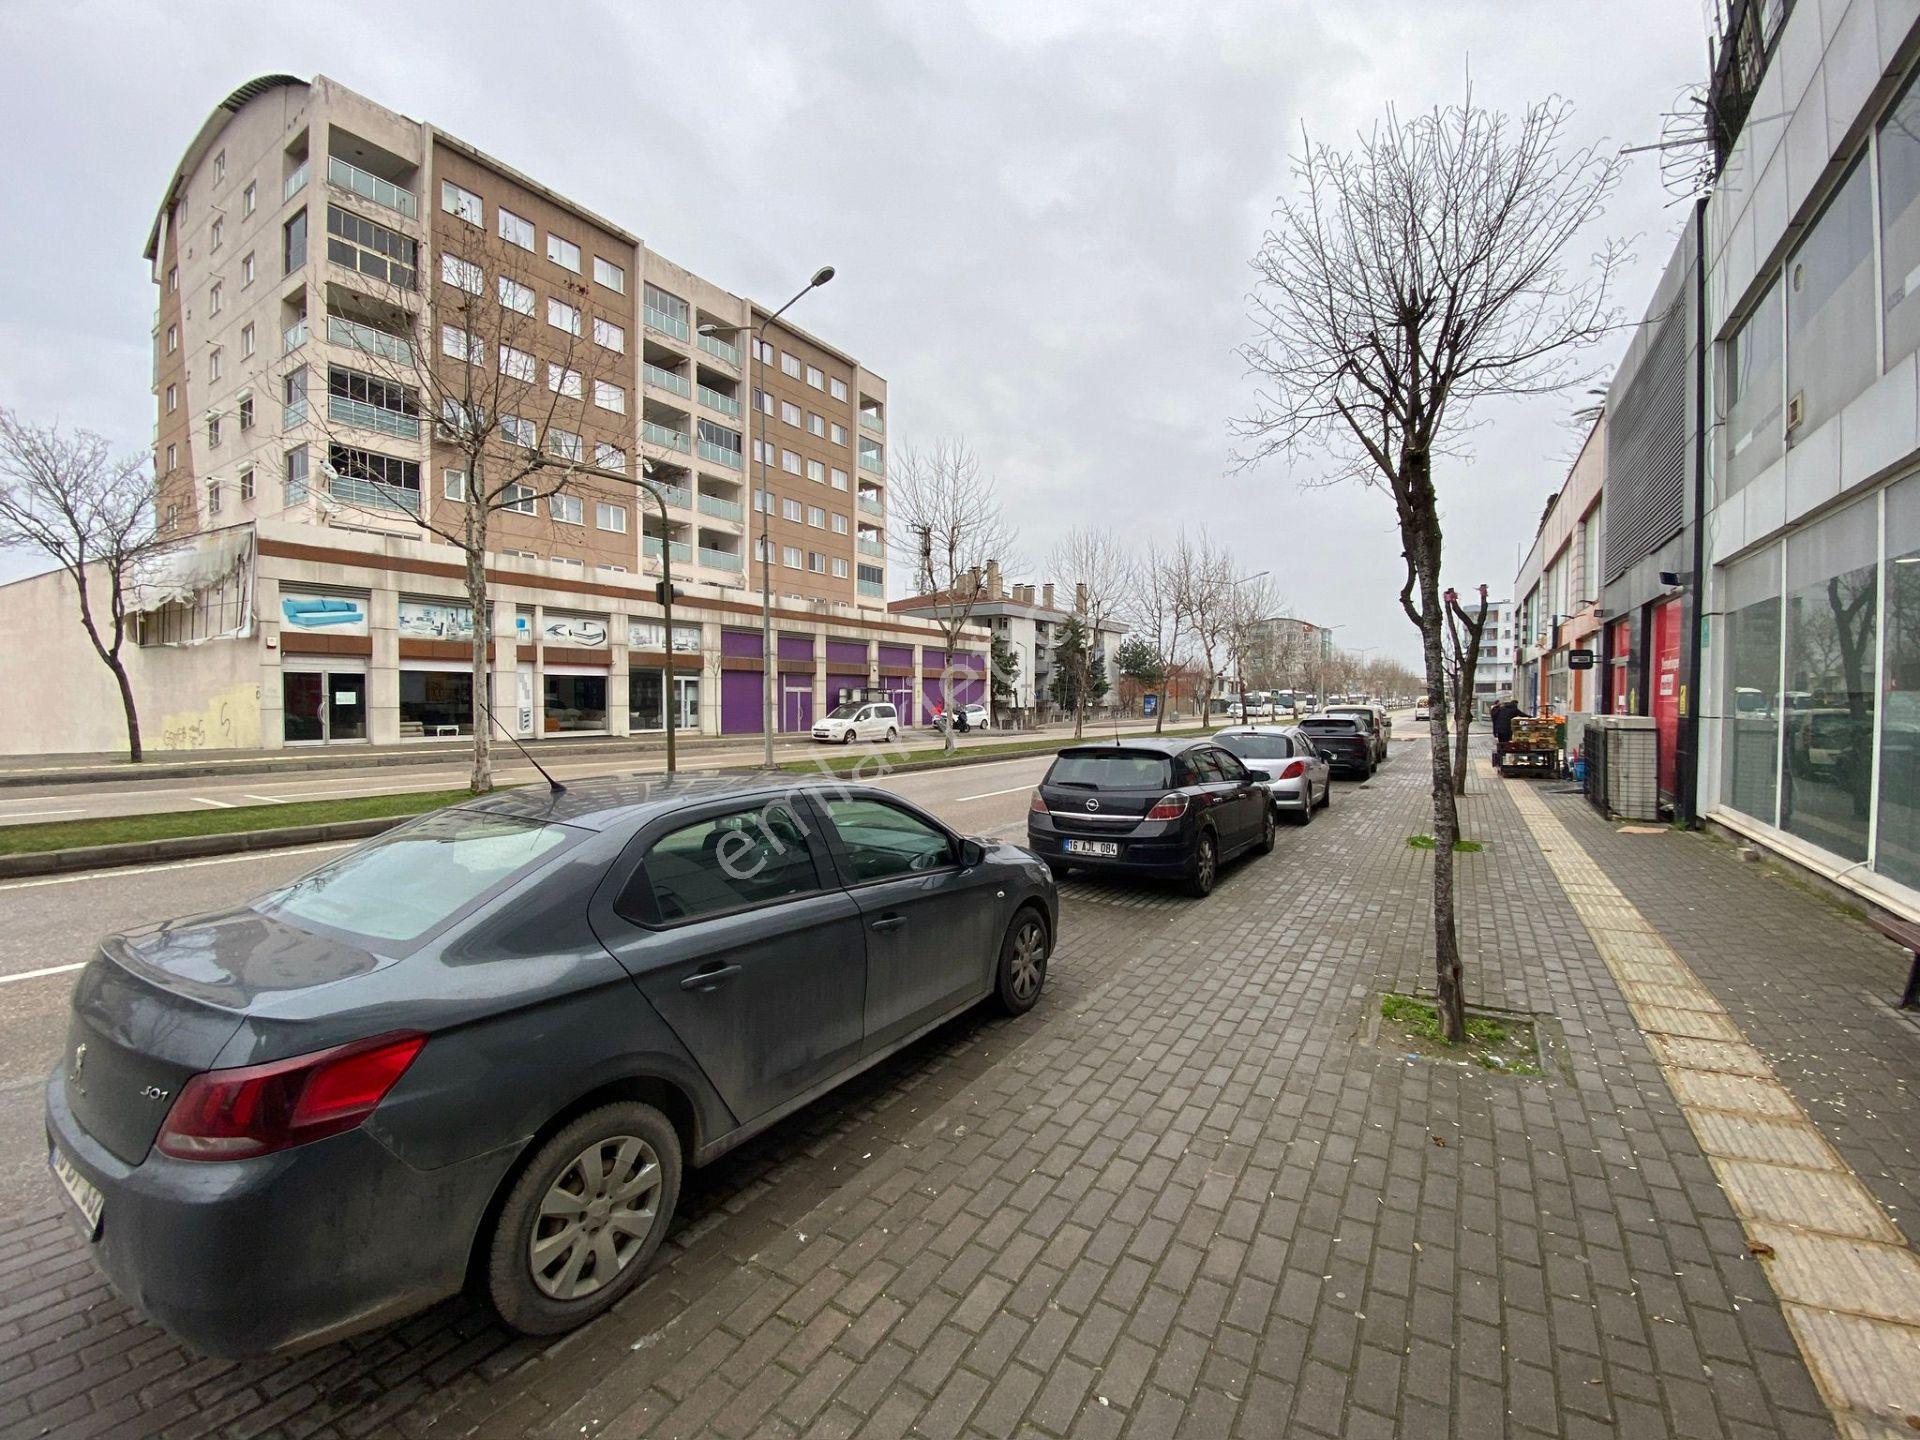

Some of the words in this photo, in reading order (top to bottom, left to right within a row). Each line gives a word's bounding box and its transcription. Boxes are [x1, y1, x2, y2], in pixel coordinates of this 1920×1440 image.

[1069, 840, 1078, 850] 16
[1081, 841, 1096, 852] AJL
[1100, 843, 1116, 854] 084
